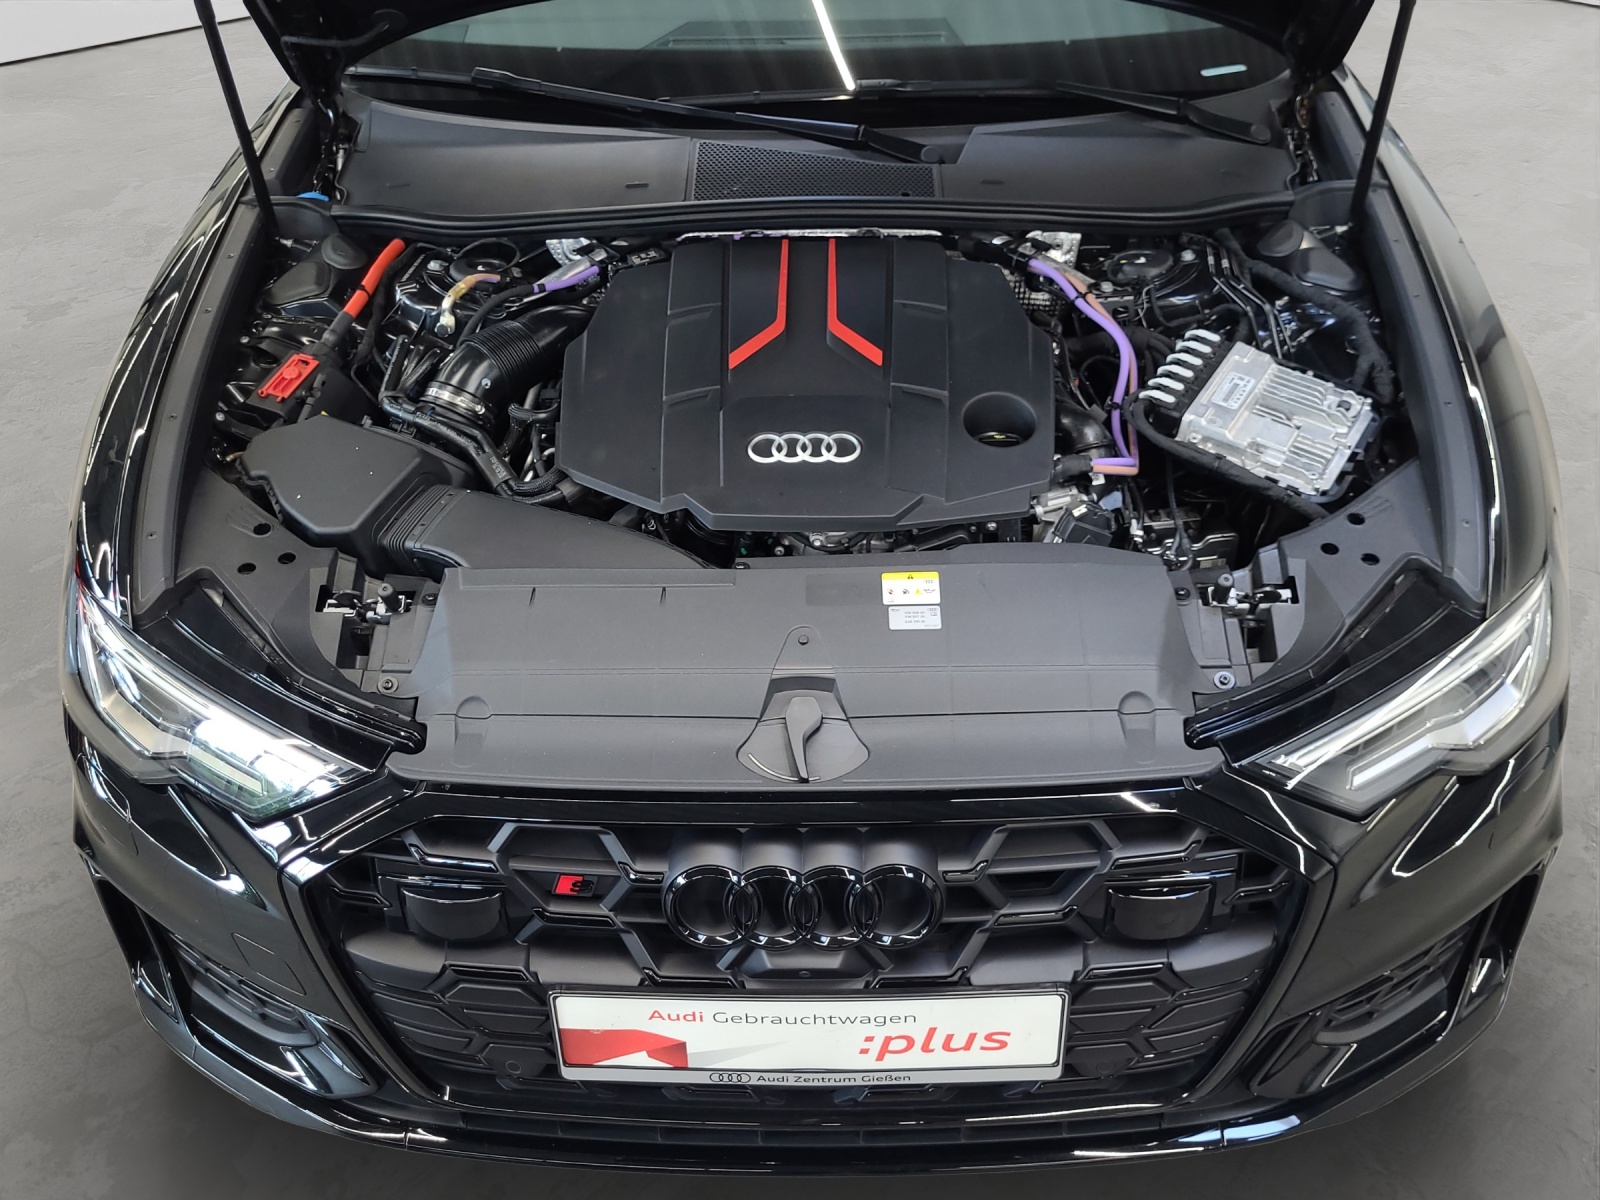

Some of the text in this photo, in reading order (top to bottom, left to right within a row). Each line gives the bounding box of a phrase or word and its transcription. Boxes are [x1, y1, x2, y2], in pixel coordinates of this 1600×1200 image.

[648, 1010, 917, 1026] Audi Gebrauchtwagen
[756, 1075, 789, 1083] Audi
[861, 1074, 911, 1082] Gießen
